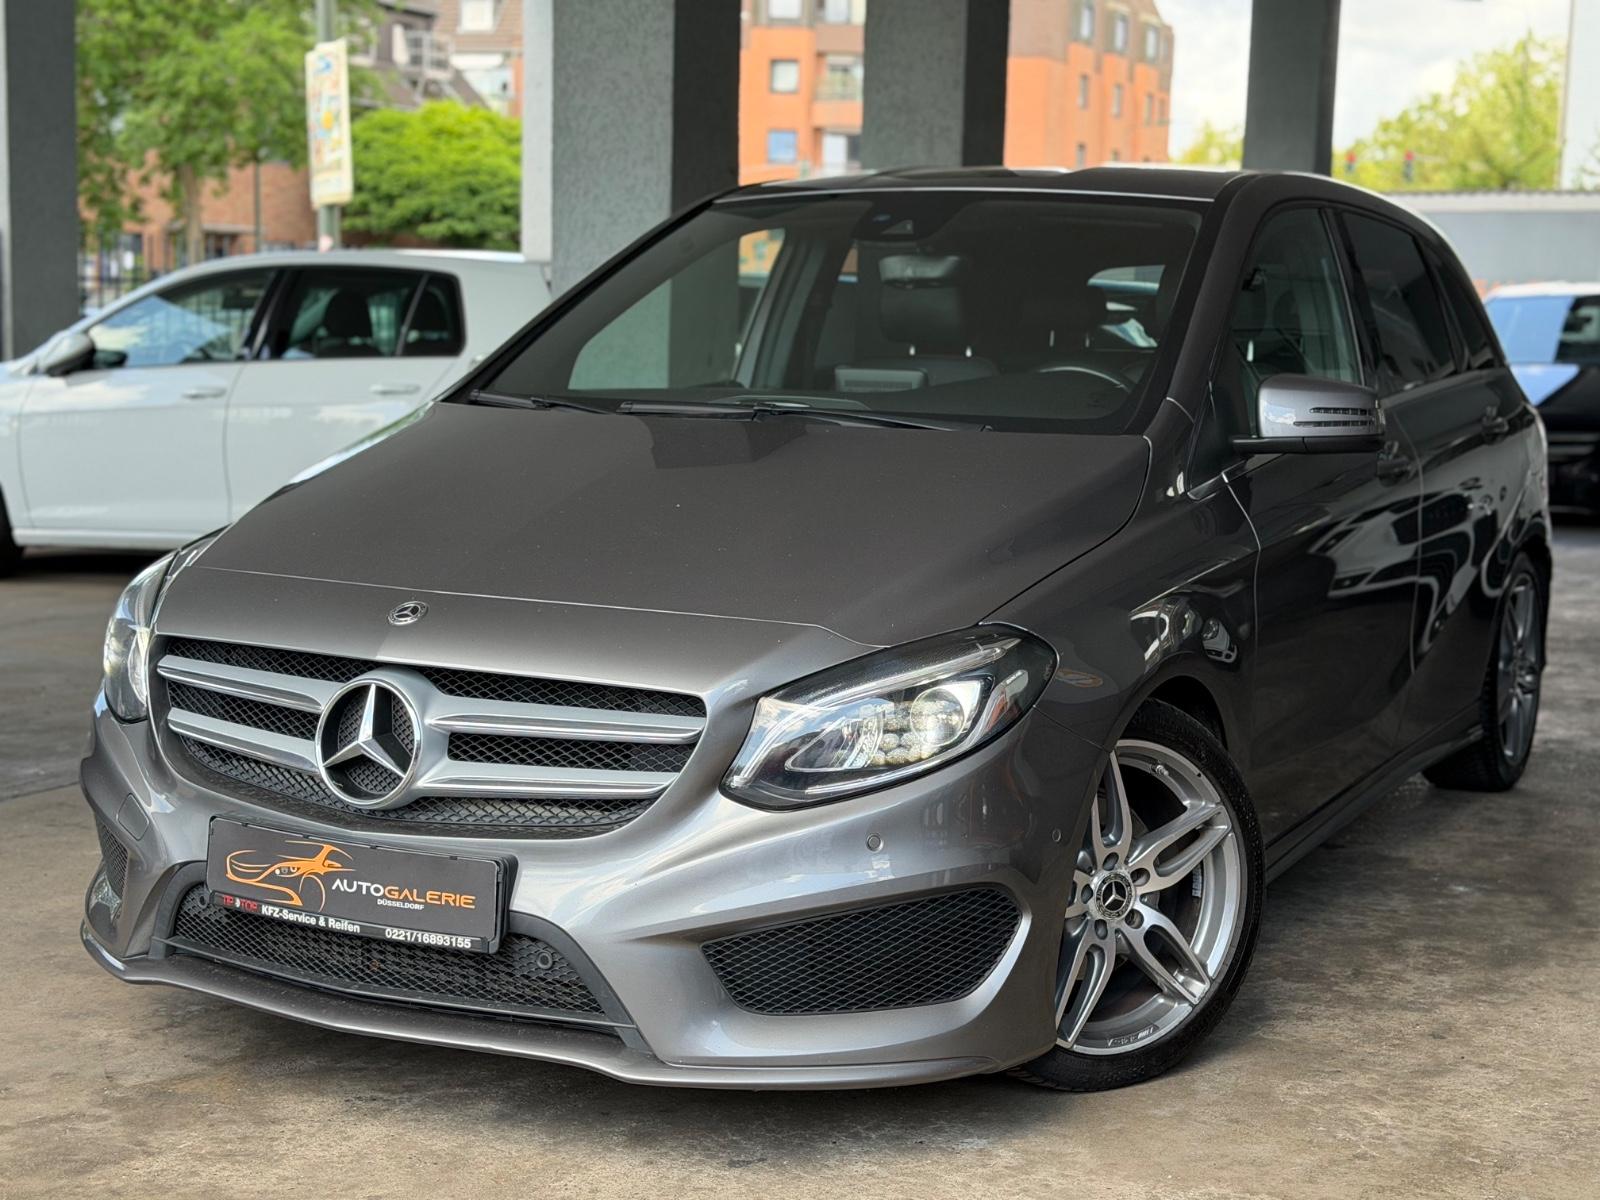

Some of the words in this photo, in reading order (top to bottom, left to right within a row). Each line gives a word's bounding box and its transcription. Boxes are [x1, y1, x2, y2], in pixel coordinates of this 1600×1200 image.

[331, 878, 476, 909] AUTOGALERIE
[377, 898, 425, 910] DÜSSELDORF
[261, 904, 317, 925] KFZ-Service
[318, 916, 326, 928] &
[328, 918, 361, 933] Reifen
[385, 928, 472, 949] 0221/16893155
